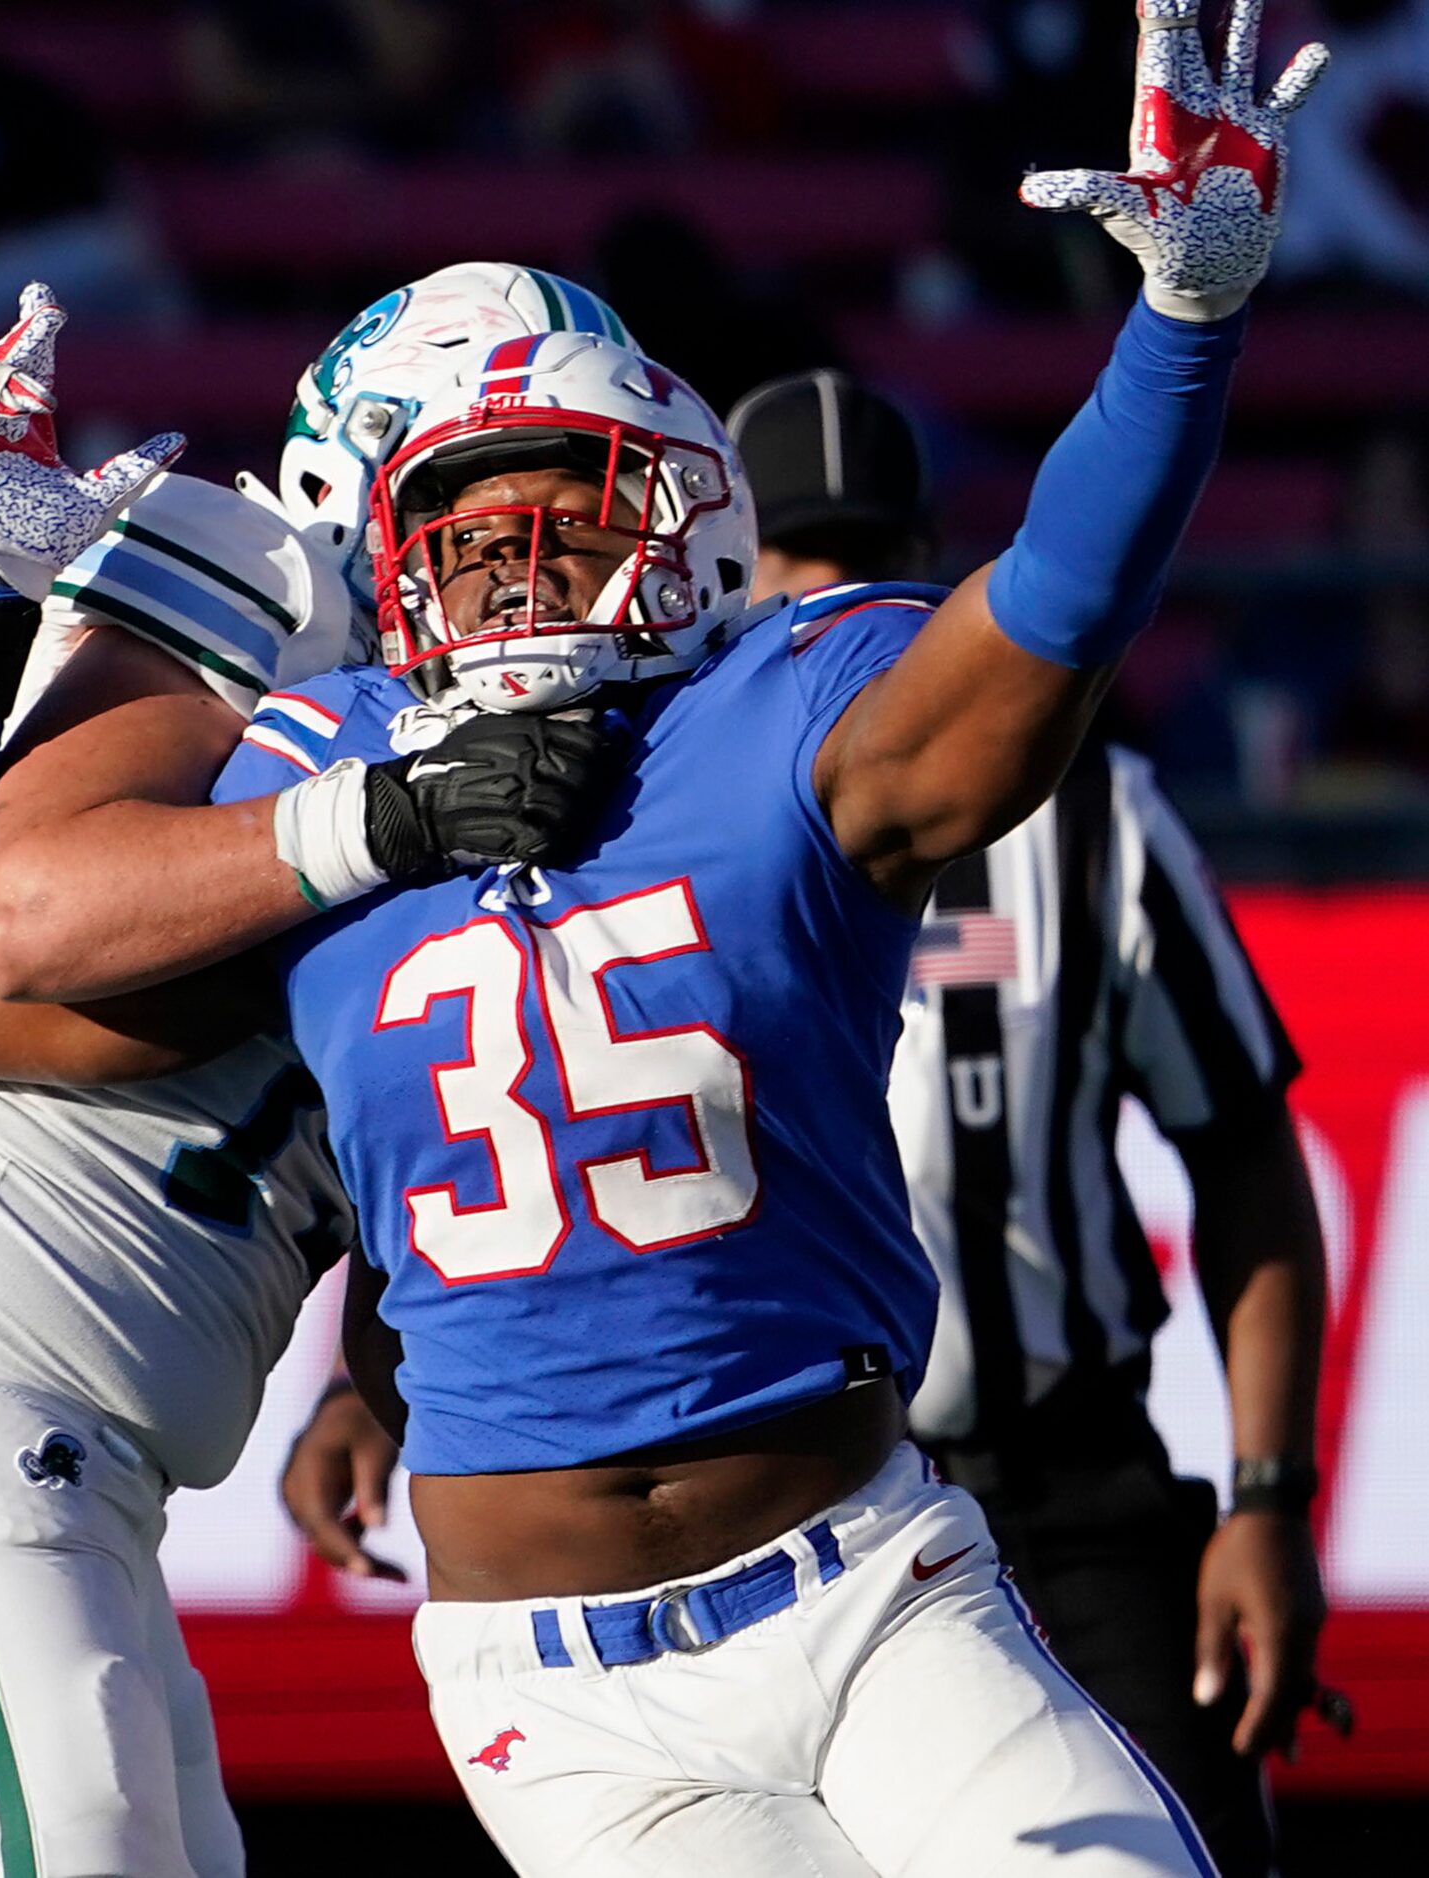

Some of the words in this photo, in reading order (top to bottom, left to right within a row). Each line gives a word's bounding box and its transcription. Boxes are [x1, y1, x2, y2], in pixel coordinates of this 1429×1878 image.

[372, 875, 763, 1287] 35
[949, 1057, 1004, 1128] U
[862, 1352, 878, 1372] L
